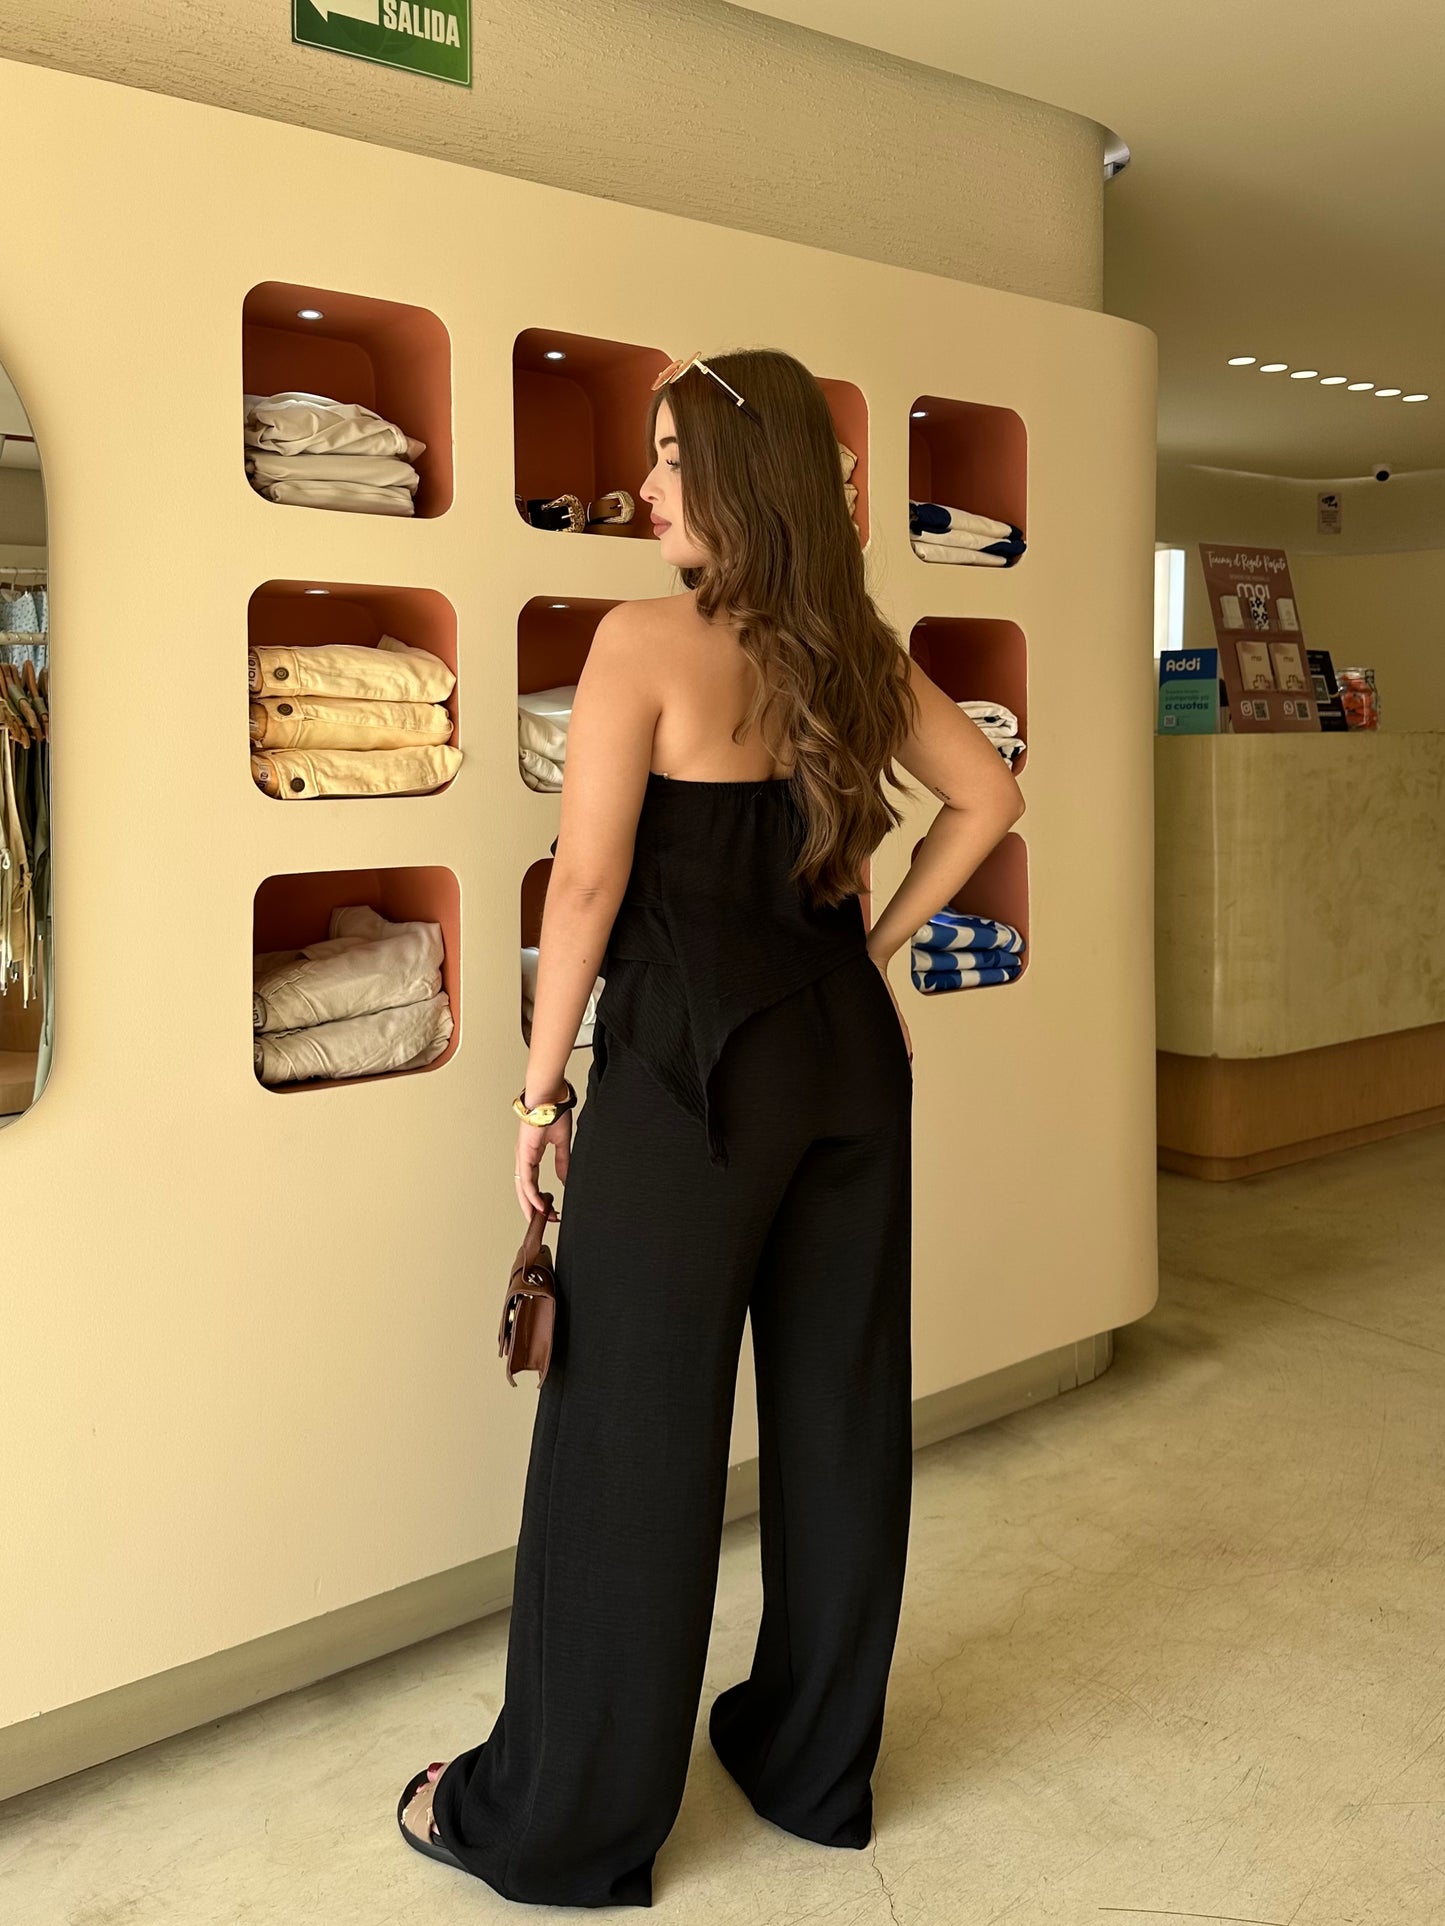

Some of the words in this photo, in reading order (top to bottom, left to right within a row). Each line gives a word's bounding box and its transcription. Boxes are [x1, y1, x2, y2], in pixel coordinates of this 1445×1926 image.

[383, 0, 461, 48] SALIDA
[1241, 553, 1262, 573] Regalo
[1166, 657, 1201, 672] Addi
[1174, 701, 1209, 711] cuotas
